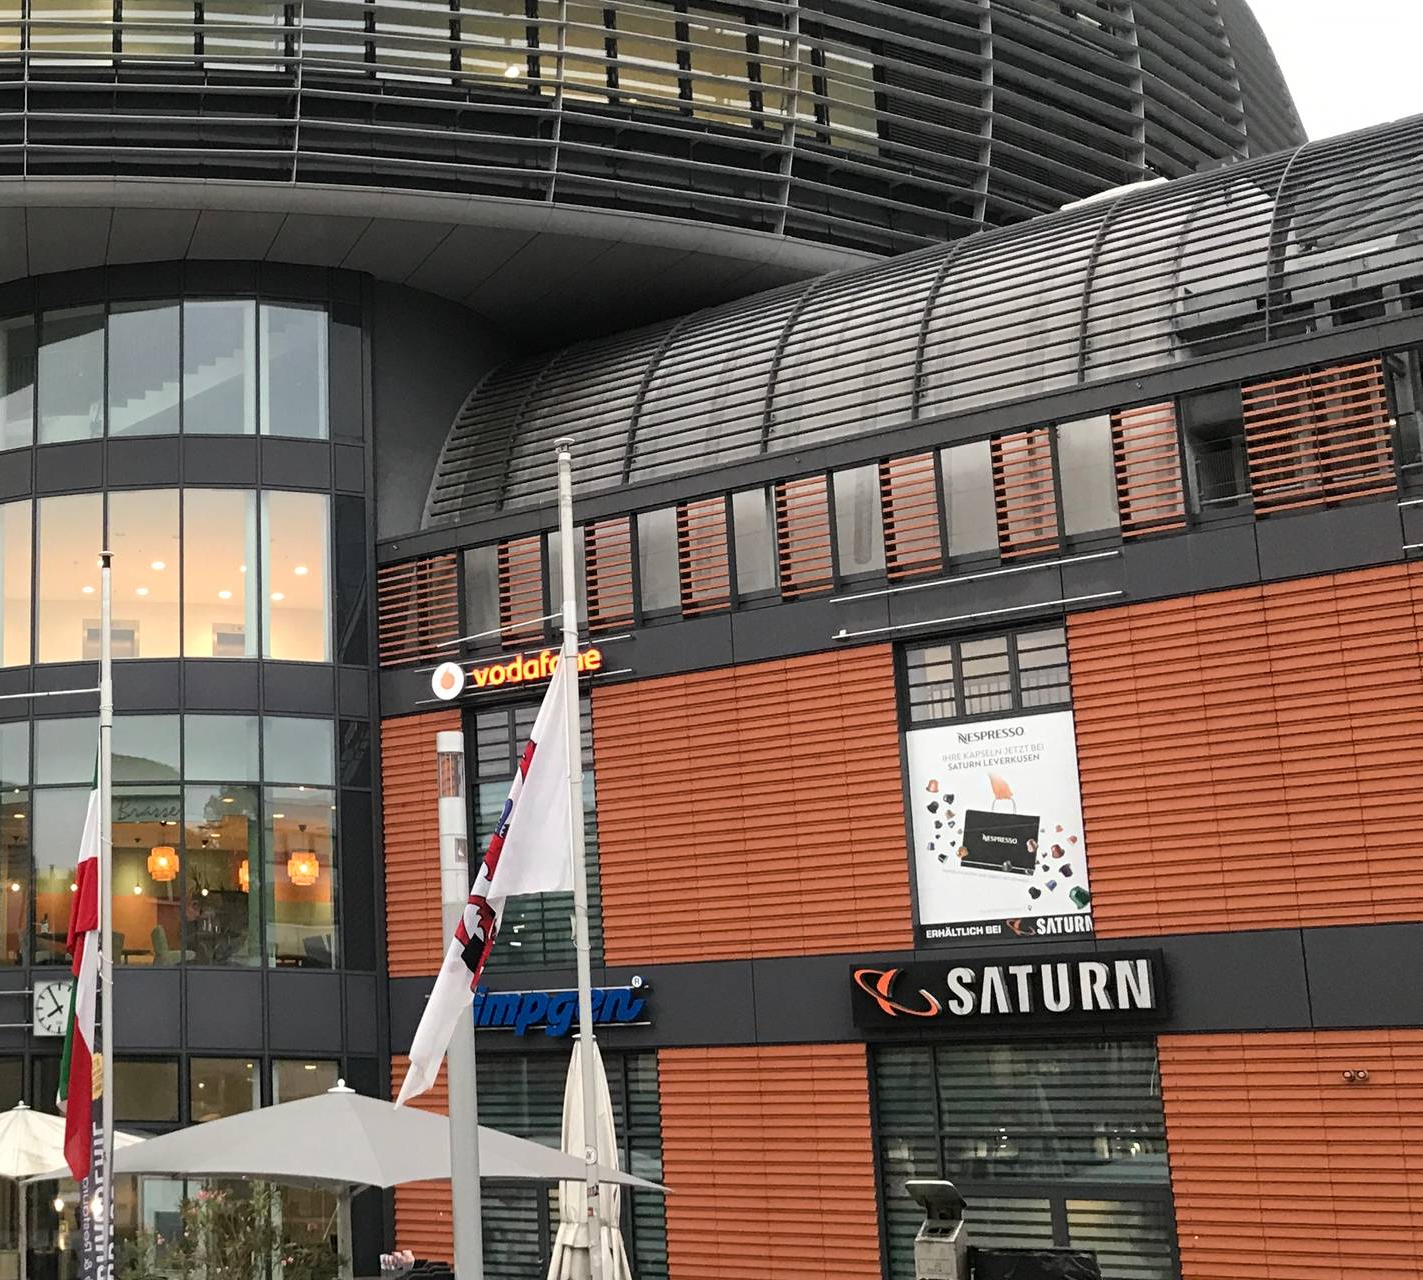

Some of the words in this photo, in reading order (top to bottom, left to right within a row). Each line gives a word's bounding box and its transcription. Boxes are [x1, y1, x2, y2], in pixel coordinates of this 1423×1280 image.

[473, 649, 602, 687] vodafoe
[957, 726, 1025, 744] NESPRESSO
[942, 754, 961, 762] IHRE
[963, 749, 1002, 761] KAPSELN
[1004, 744, 1029, 756] JETZT
[1031, 743, 1045, 752] BEI
[947, 759, 982, 771] SATURN
[983, 753, 1040, 767] LEVERKUSEN
[118, 800, 181, 821] Brasse
[982, 832, 1018, 845] NESPRESSO
[926, 925, 984, 939] ERHÄLTLICH
[985, 924, 1002, 935] BEI
[1036, 914, 1093, 936] SATURN
[947, 959, 1152, 1016] SATURN
